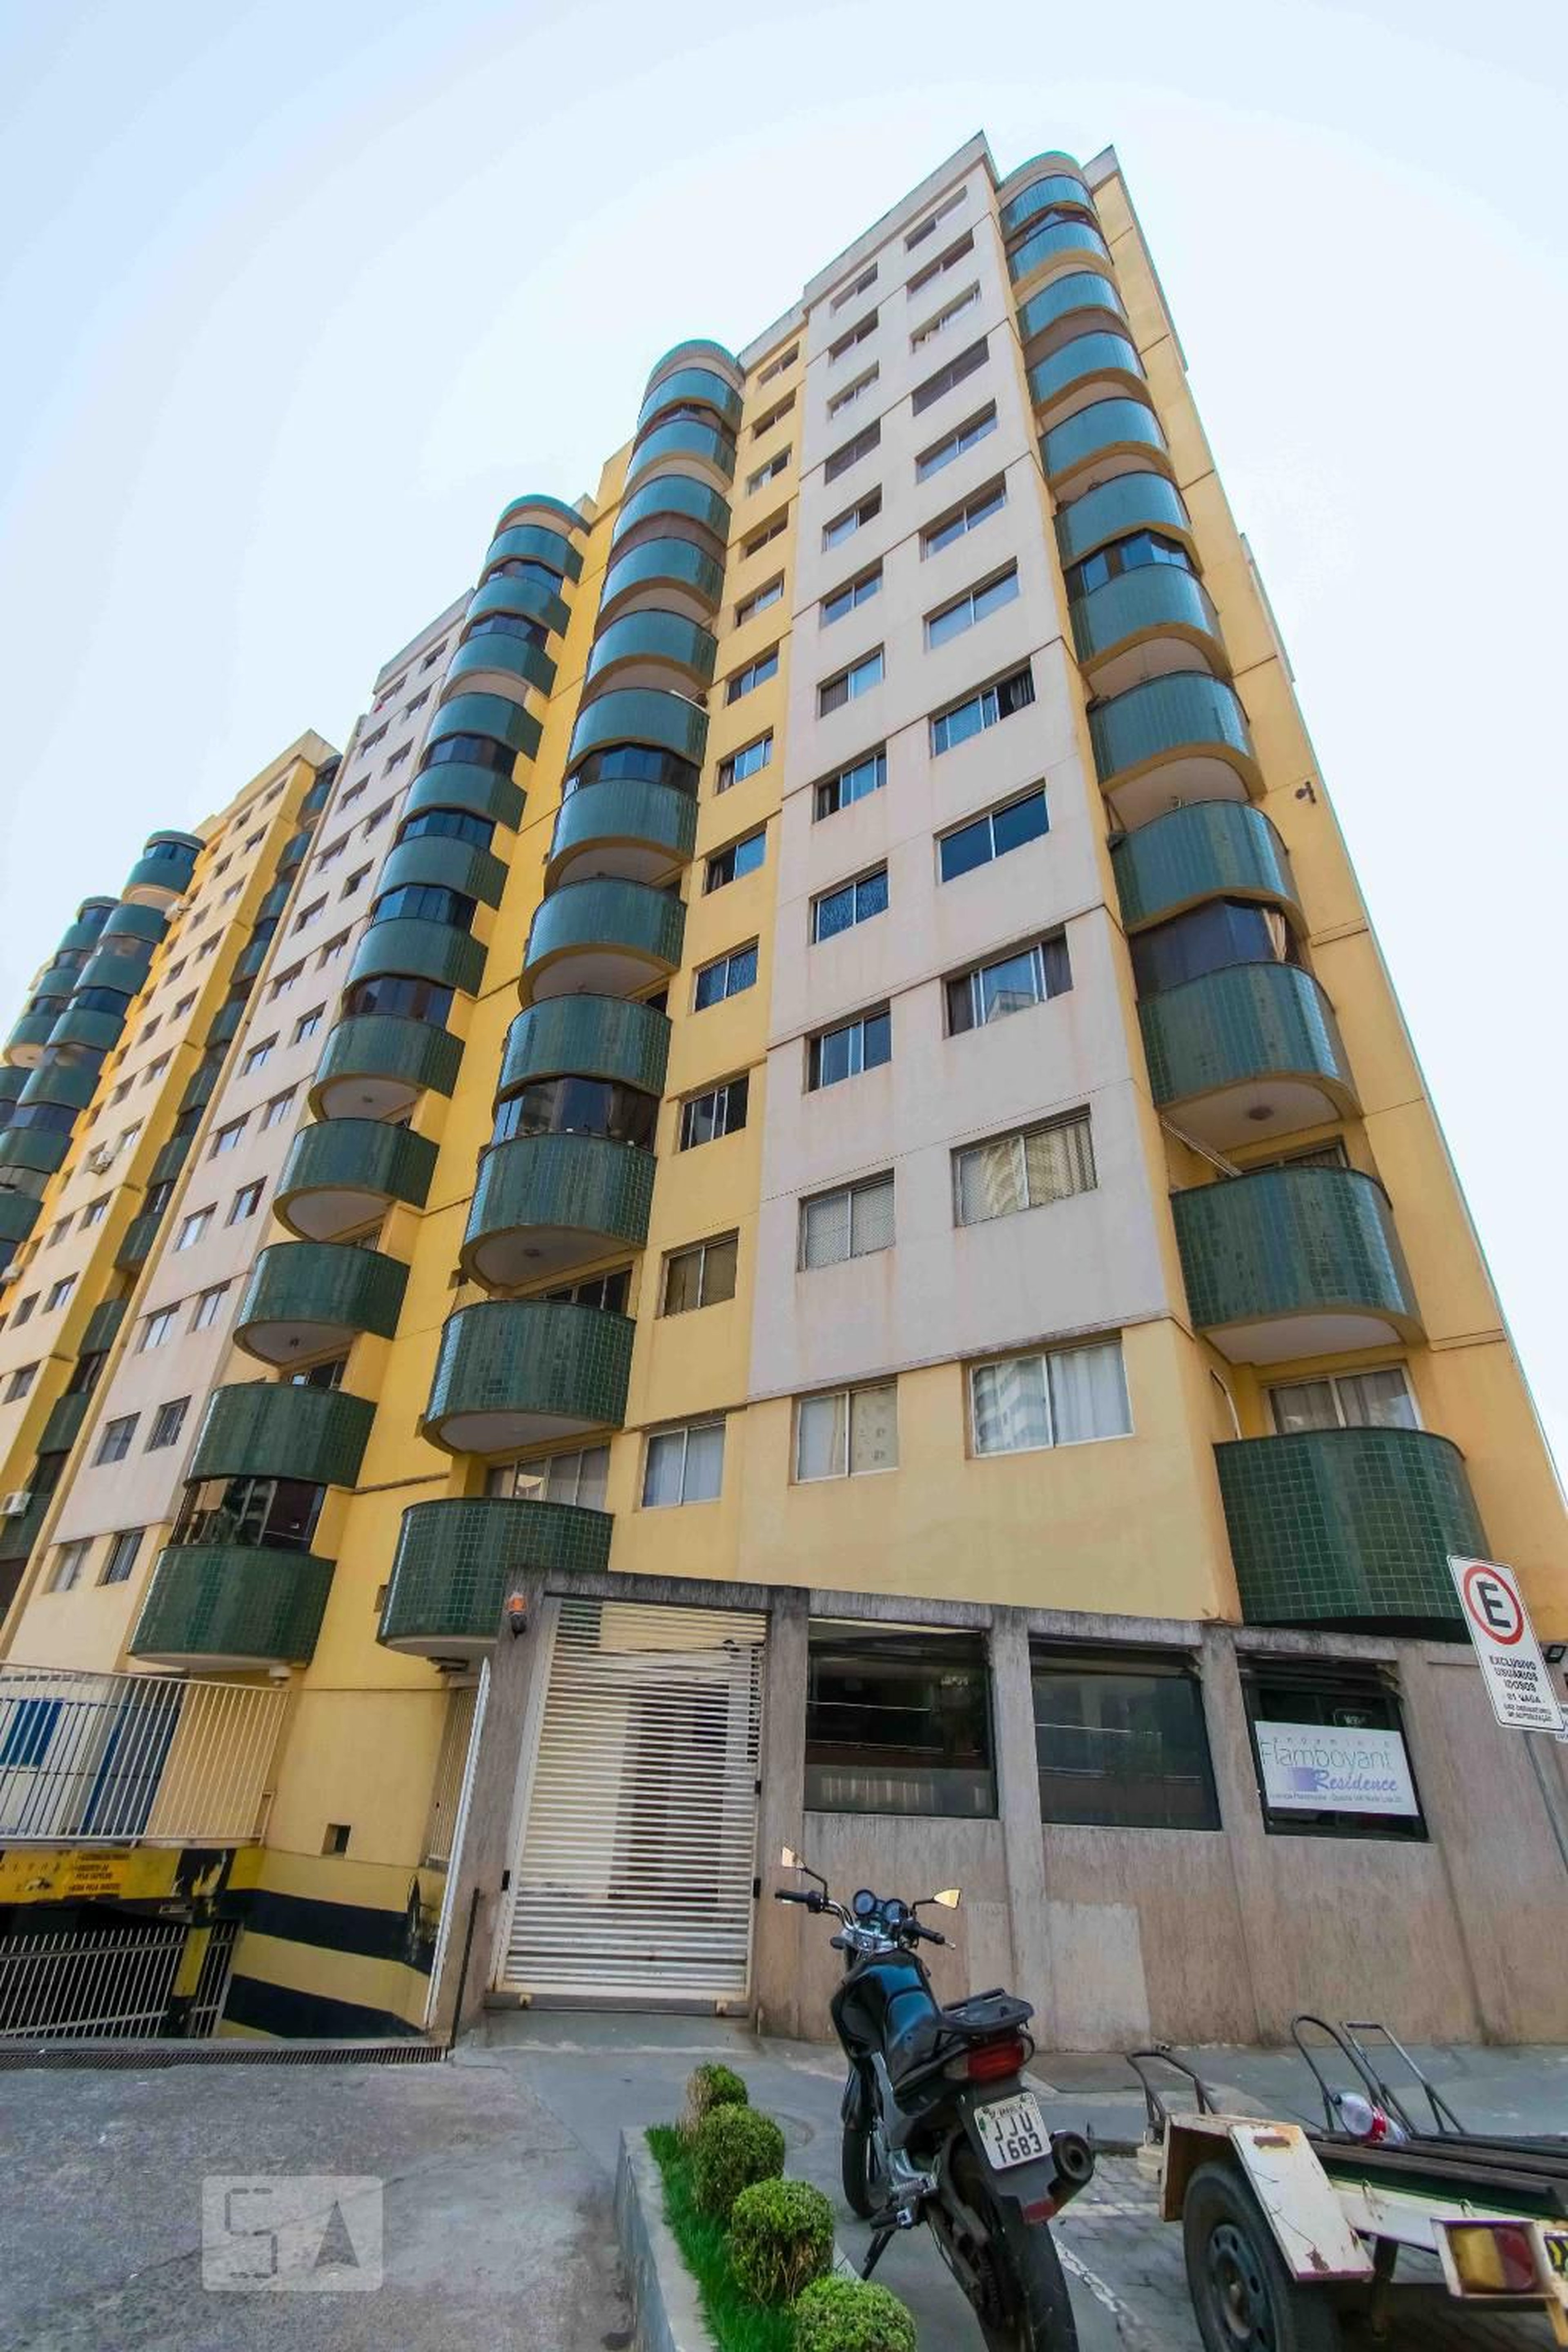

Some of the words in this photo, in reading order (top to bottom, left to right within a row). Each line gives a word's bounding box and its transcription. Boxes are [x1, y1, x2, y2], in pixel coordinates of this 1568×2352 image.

[1476, 1581, 1512, 1628] E
[1489, 1655, 1537, 1670] EXCLUSIVO
[1260, 1741, 1392, 1772] Flamboyant
[1312, 1769, 1397, 1791] Residence
[995, 2111, 1033, 2142] JJU
[998, 2132, 1042, 2165] 1683
